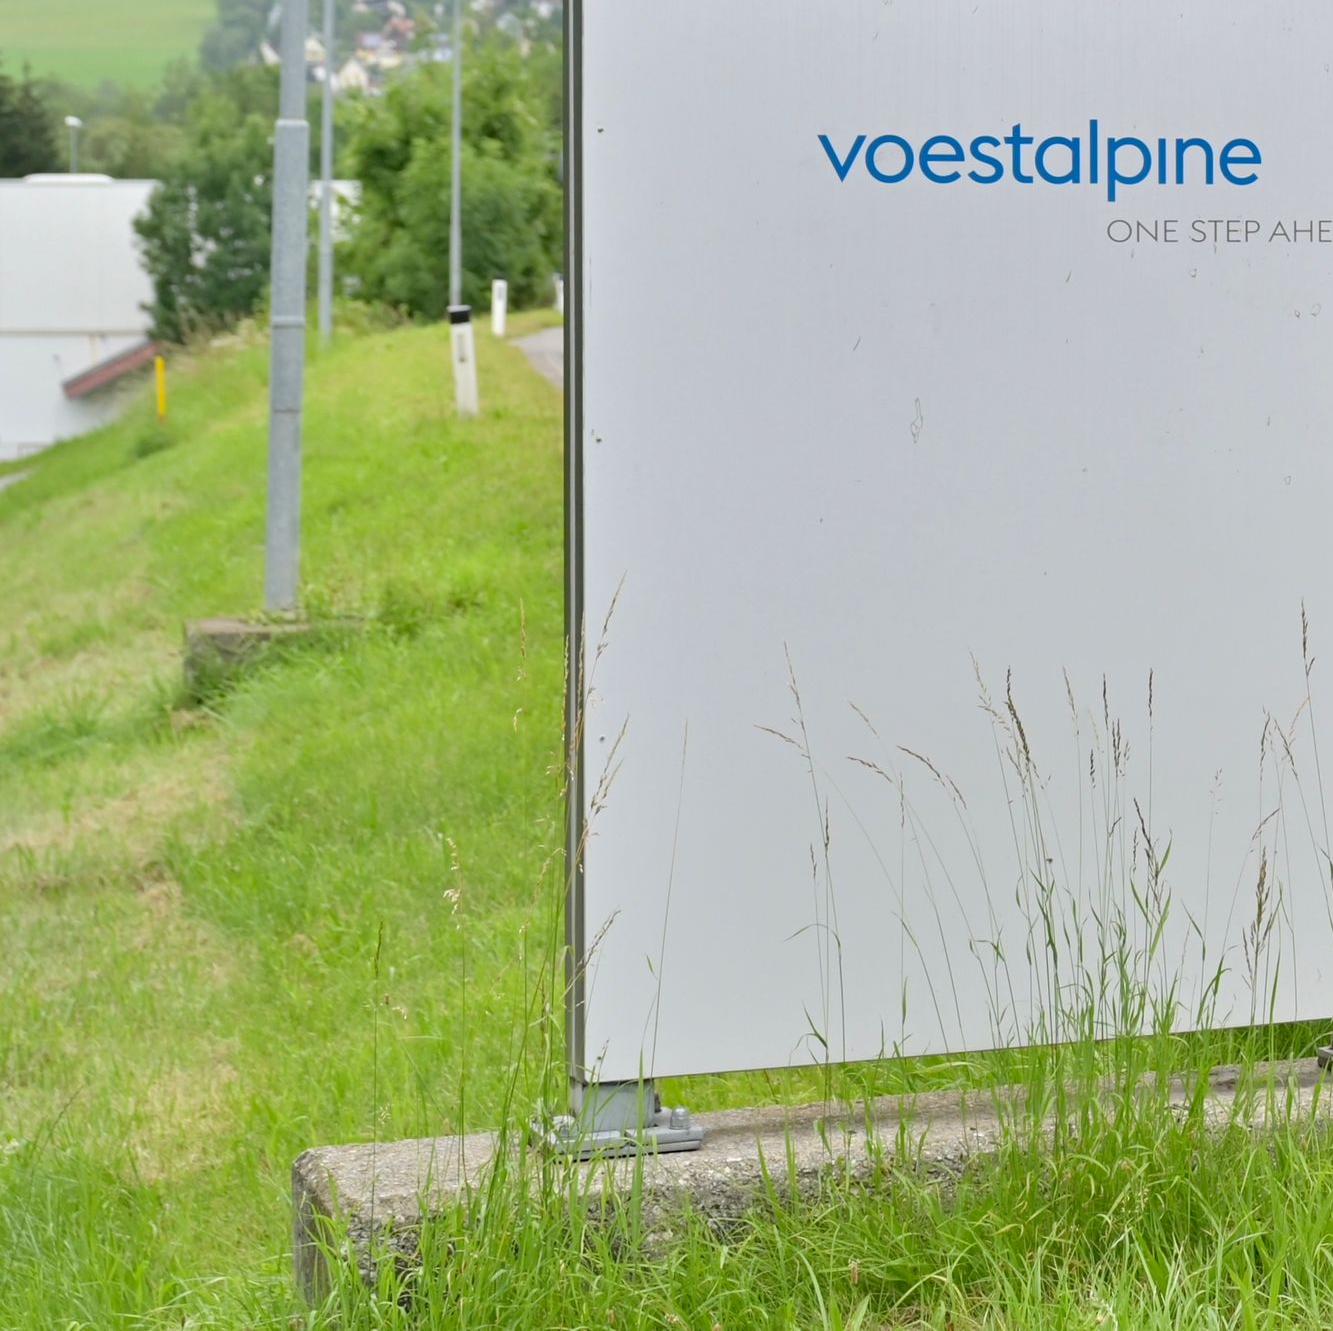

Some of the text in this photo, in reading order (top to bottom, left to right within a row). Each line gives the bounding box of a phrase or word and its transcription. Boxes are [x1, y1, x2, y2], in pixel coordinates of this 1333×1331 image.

[817, 119, 1262, 203] voestalpine
[1106, 219, 1179, 243] ONE
[1191, 219, 1261, 243] STEP
